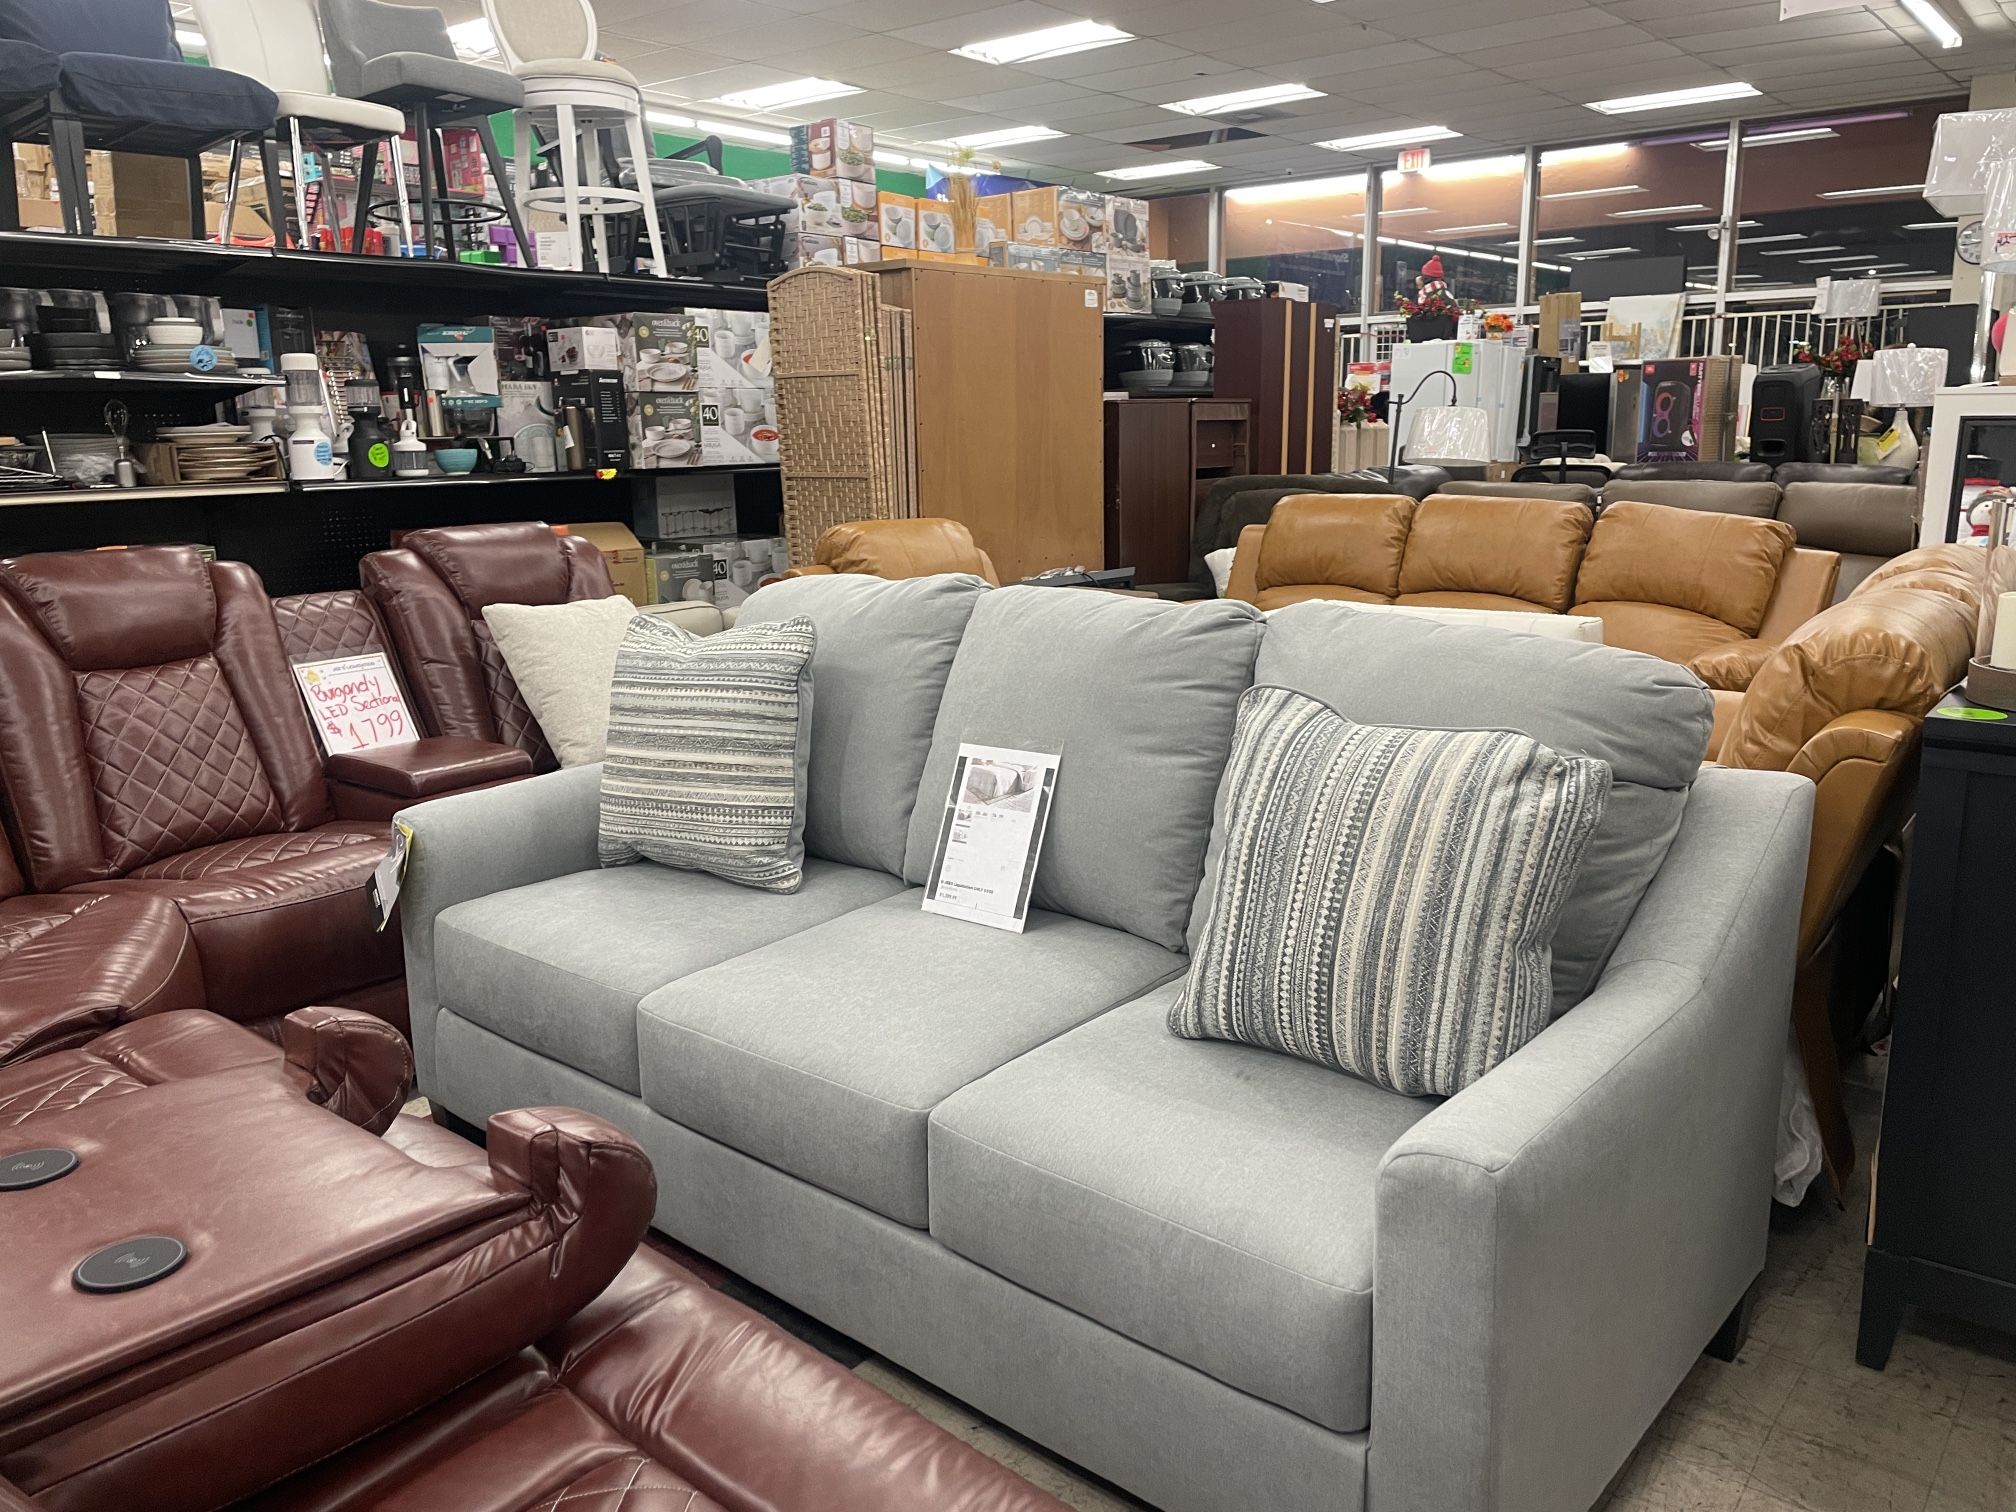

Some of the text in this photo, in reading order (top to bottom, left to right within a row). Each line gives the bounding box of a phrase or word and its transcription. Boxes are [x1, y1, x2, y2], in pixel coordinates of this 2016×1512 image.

[1404, 150, 1424, 169] EXIT
[702, 406, 718, 421] 40
[310, 673, 382, 704] Burgandy
[319, 691, 401, 721] LED Sectional
